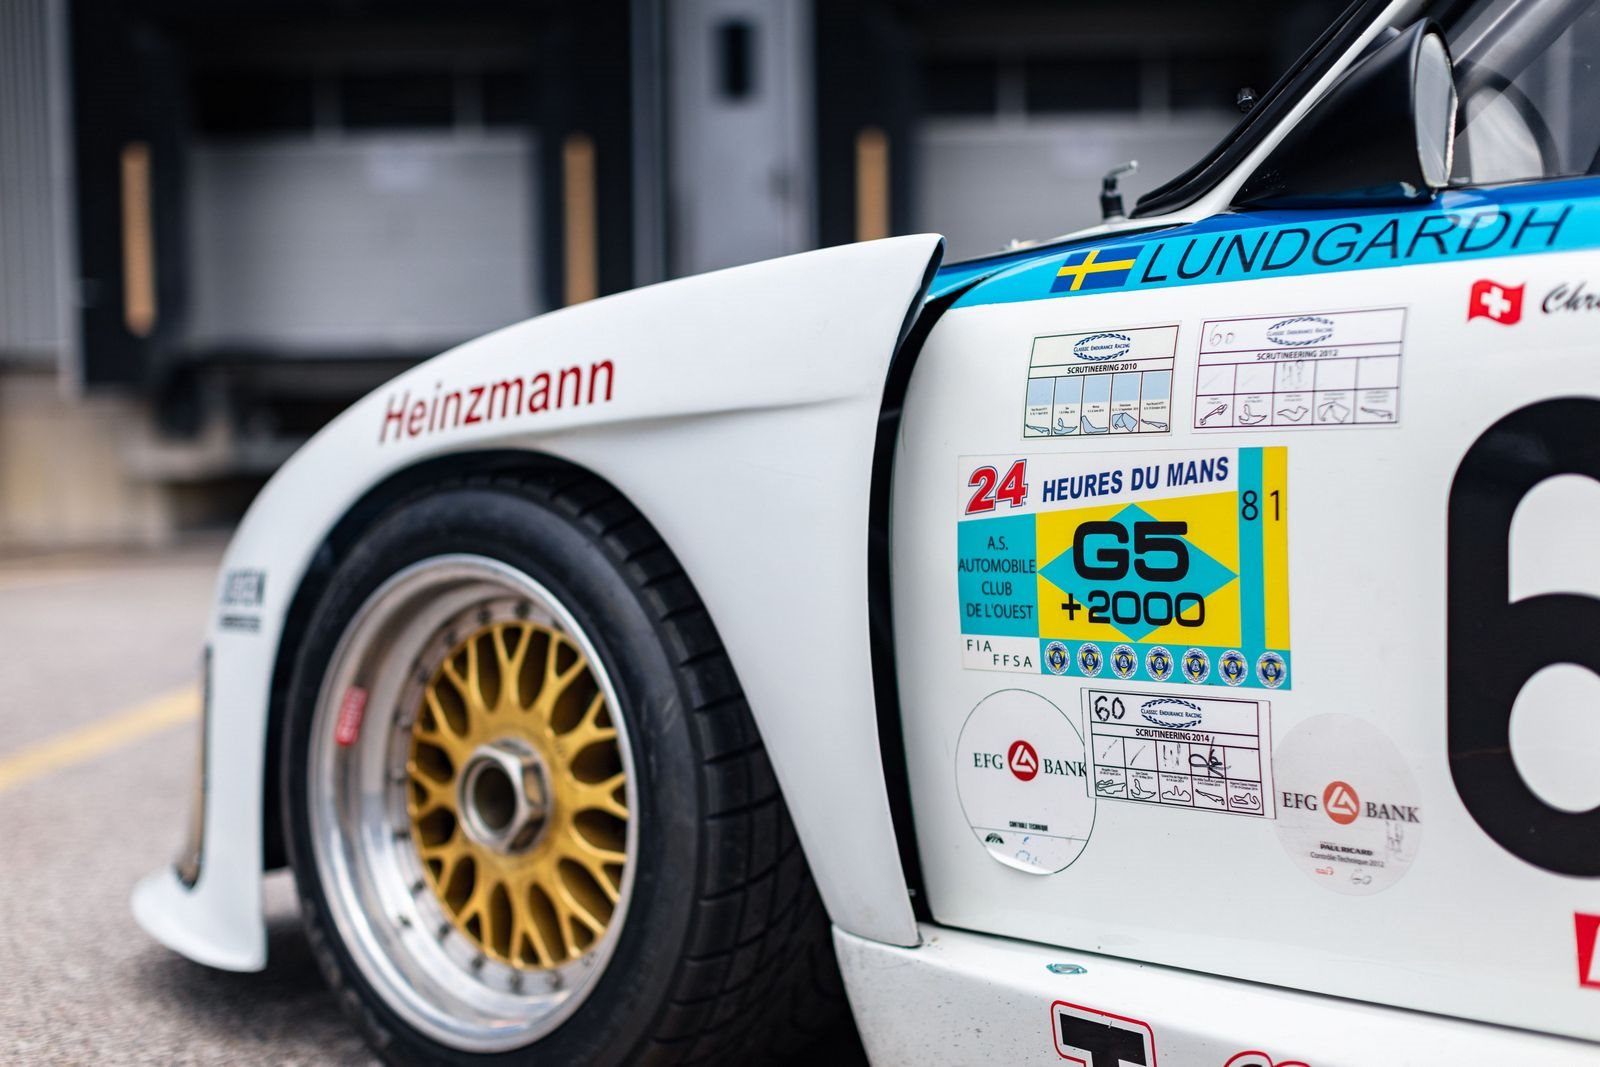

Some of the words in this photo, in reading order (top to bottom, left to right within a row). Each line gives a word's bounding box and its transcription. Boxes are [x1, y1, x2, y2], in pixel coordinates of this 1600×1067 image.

[1141, 205, 1575, 283] LUNDGARDH
[1541, 281, 1600, 314] Chr
[1256, 350, 1317, 360] SCRUTINEERING
[1067, 363, 1120, 375] SCRUTINEERING
[1120, 362, 1138, 371] 2010
[379, 358, 615, 443] Heinzmann
[965, 458, 1029, 515] 24
[1042, 470, 1123, 502] HEURES
[1130, 465, 1160, 491] DU
[1166, 456, 1229, 487] MANS
[1241, 490, 1259, 521] 8
[1270, 490, 1281, 521] 1
[987, 536, 1009, 551] A.S.
[1073, 521, 1190, 582] G5
[958, 558, 1036, 574] AUTOMOBILE
[981, 581, 1012, 596] CLUB
[966, 603, 982, 618] DE
[985, 603, 1034, 619] L'OUEST
[1061, 590, 1205, 627] +2000
[966, 639, 993, 652] FIA
[993, 653, 1032, 668] FFSA
[1094, 695, 1126, 722] 60
[1140, 708, 1158, 716] CLASSIC
[1159, 709, 1184, 717] ENDURANCE
[1135, 728, 1191, 741] SCRUTINEERING
[1191, 732, 1210, 742] 2014
[973, 752, 1004, 770] EFG
[1043, 758, 1087, 777] BANK
[1282, 791, 1319, 812] EFG
[1365, 801, 1421, 824] BANK
